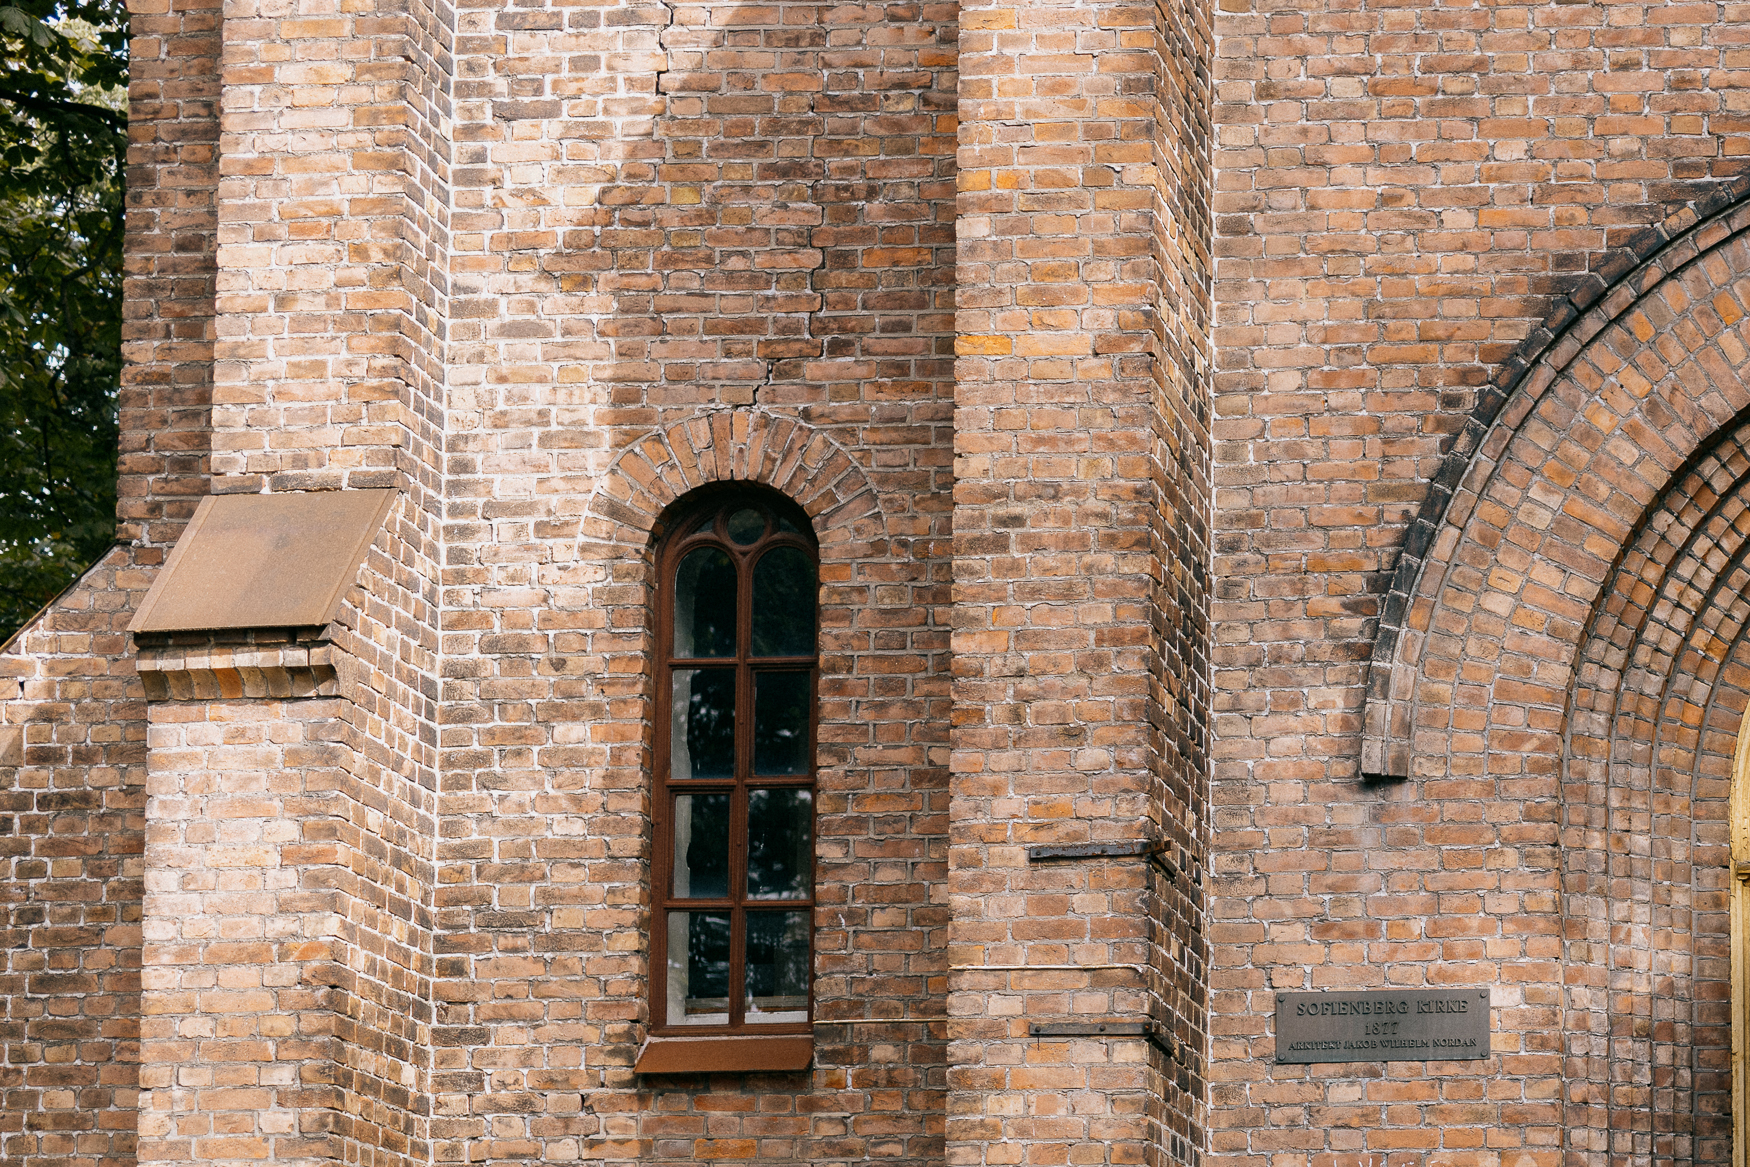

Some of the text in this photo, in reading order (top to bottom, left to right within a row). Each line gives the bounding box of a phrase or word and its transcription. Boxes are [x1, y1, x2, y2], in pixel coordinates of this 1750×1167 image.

[1296, 1000, 1469, 1016] SOFIENBERG KIRKE
[1364, 1021, 1400, 1035] 1877
[1288, 1038, 1477, 1051] ARKITEKT JAKOB WILHELM NORDAN
